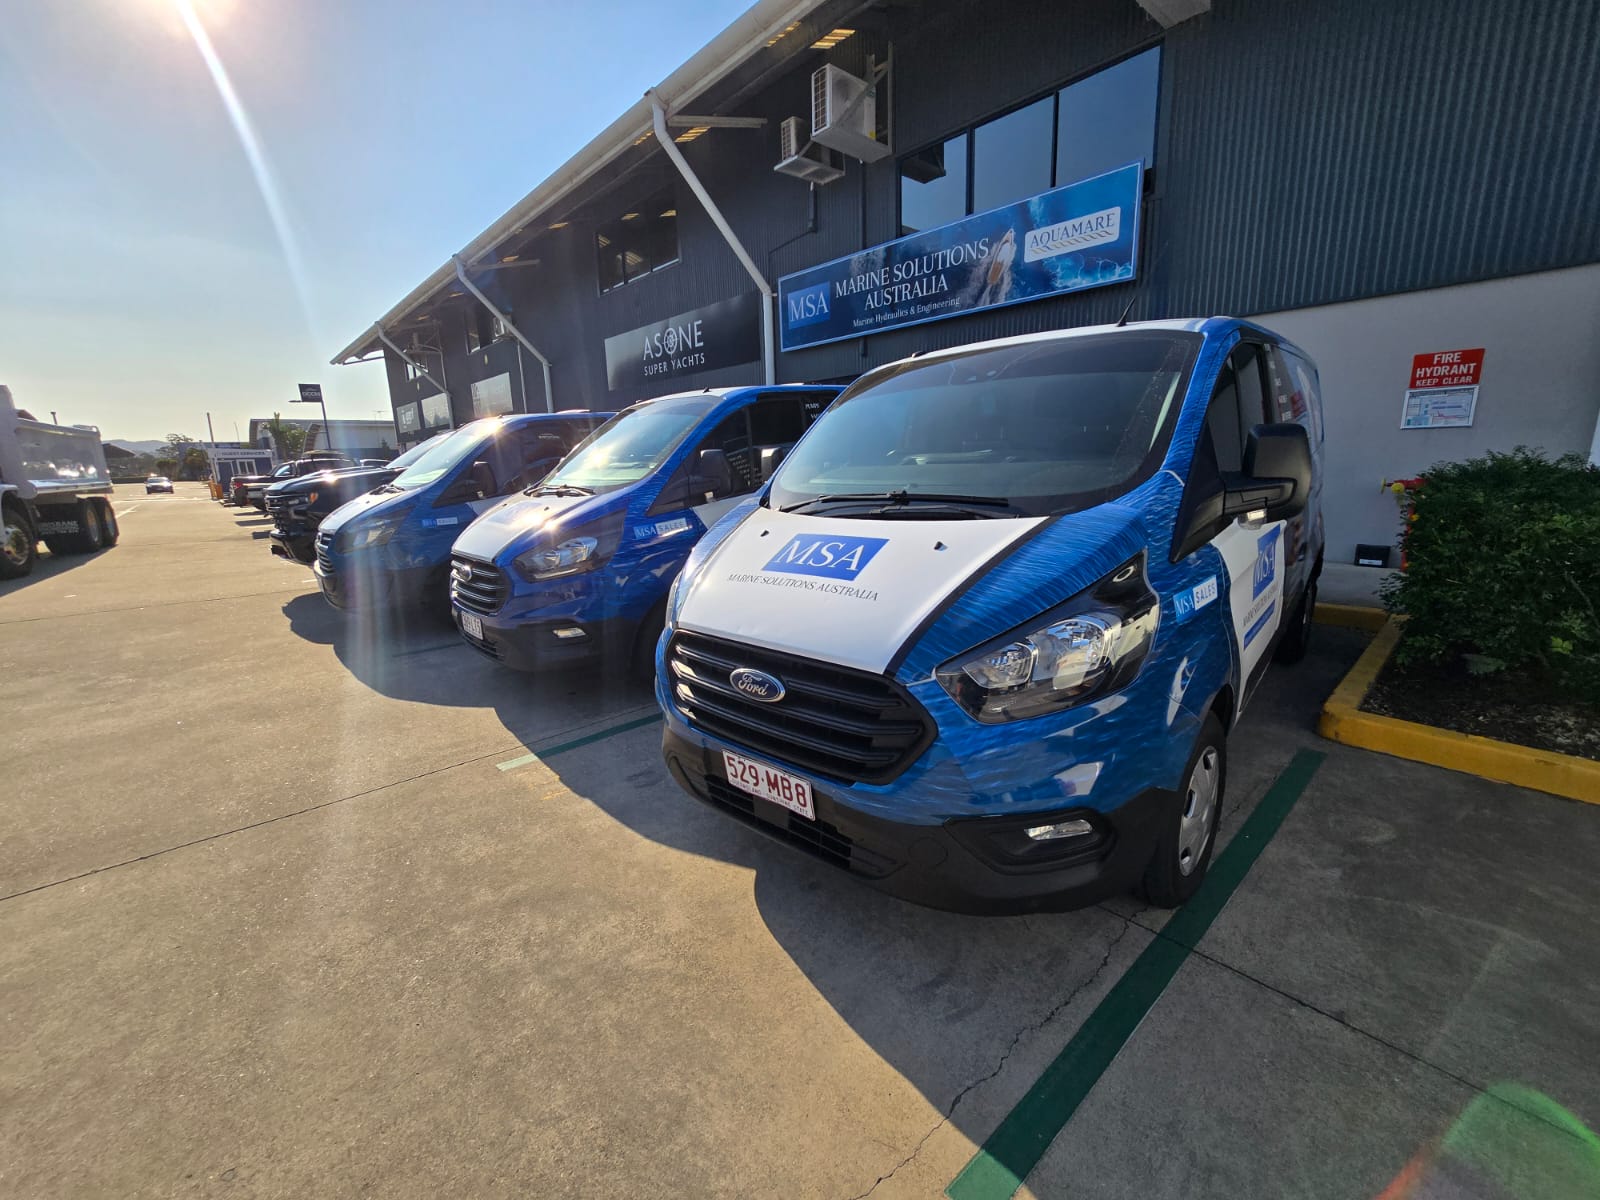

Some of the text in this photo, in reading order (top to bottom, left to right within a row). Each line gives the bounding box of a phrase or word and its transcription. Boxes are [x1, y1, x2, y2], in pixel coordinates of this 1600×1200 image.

[1030, 213, 1115, 250] AQUAMARE
[835, 238, 989, 298] MARINE SOLUTIONS
[789, 291, 829, 322] MSA
[864, 274, 948, 310] AUSTRALIA
[853, 296, 961, 328] Marine Hydraulics & Engineering
[644, 352, 705, 376] SUPER YACHTS
[1416, 363, 1477, 378] HYDRANT
[1433, 352, 1462, 365] FIRE
[1416, 375, 1473, 387] KEEP CLEAR
[636, 526, 657, 537] MSA
[775, 540, 865, 571] MSA
[728, 573, 879, 601] MARINE SOLUTIONS AUSTRALIA
[1176, 583, 1216, 617] MSA SALES
[738, 673, 769, 696] Ford
